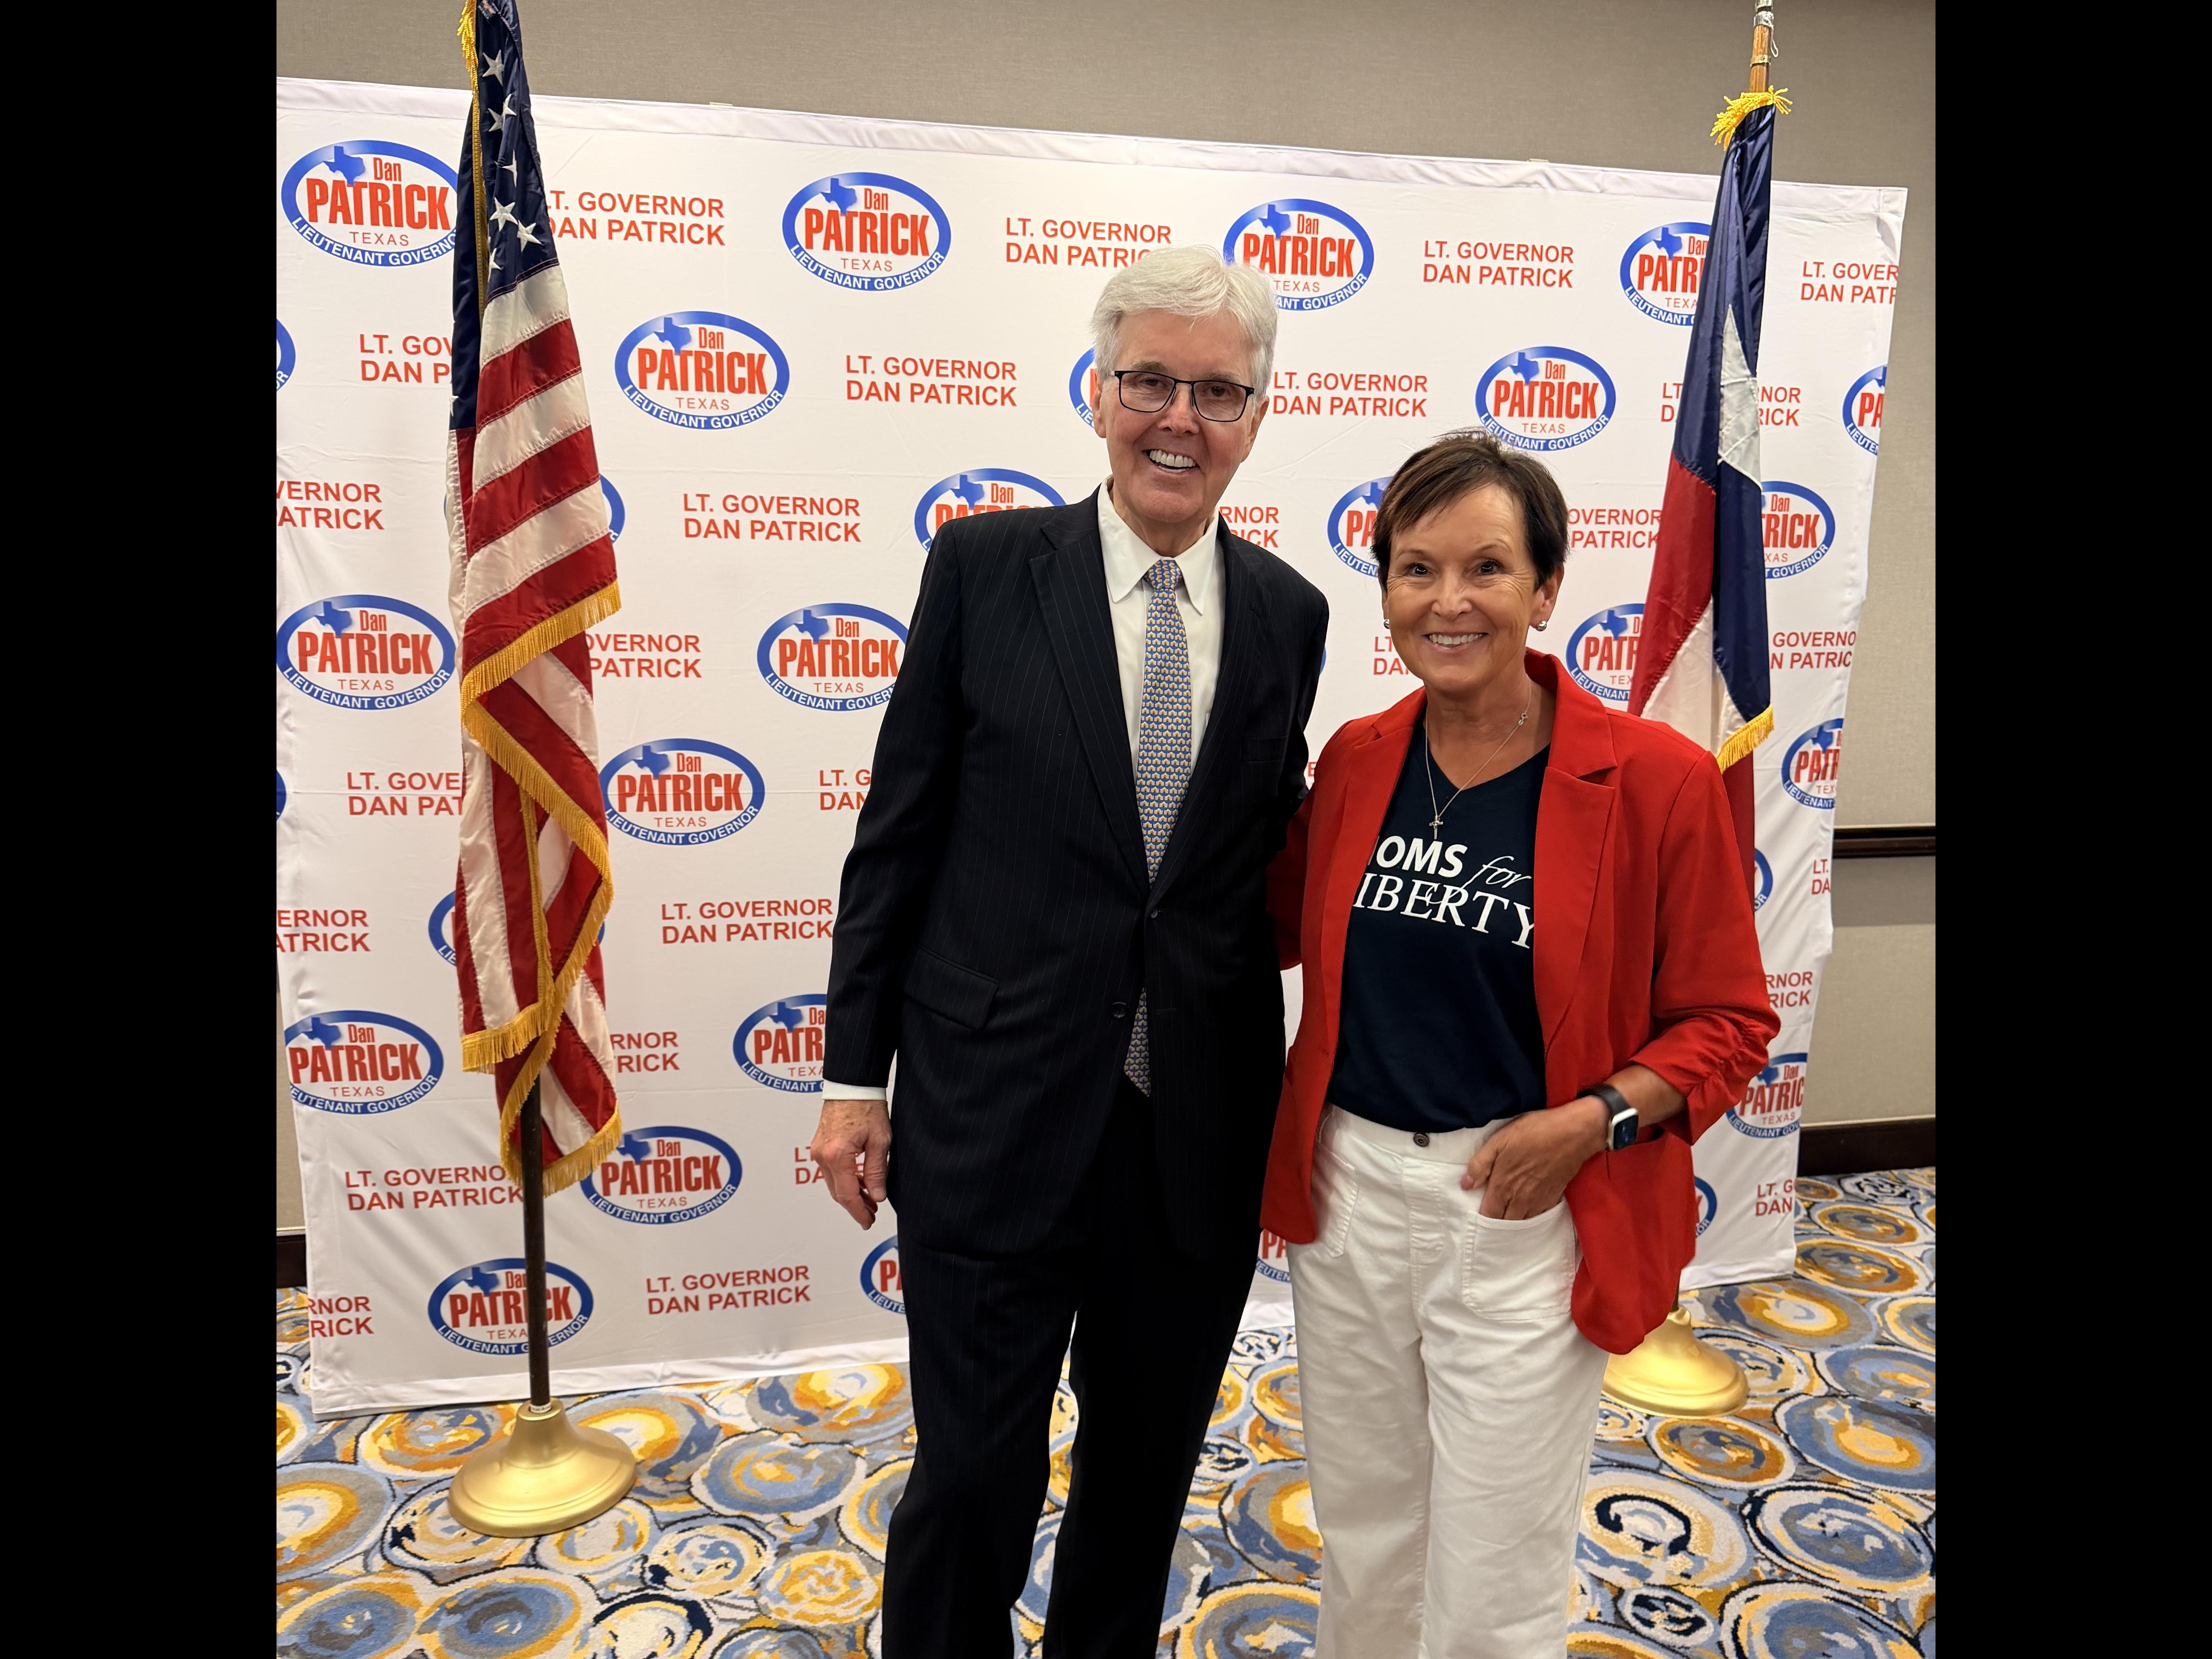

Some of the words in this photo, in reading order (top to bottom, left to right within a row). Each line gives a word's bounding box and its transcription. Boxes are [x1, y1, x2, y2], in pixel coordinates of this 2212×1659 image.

[373, 157, 402, 182] Dan
[306, 178, 451, 230] PATRICK
[547, 190, 569, 210] T.
[578, 192, 724, 218] GOVERNOR
[864, 188, 888, 211] Dan
[608, 219, 725, 246] PATRICK
[804, 208, 929, 257] PATRICK
[1006, 217, 1034, 237] LT.
[1042, 219, 1171, 244] GOVERNOR
[1297, 213, 1319, 235] Dan
[292, 217, 385, 264] LIEUTENANT
[389, 229, 456, 265] GOVERNO
[349, 232, 409, 247] TEXAS
[1006, 242, 1058, 265] DAN
[1243, 233, 1355, 278] PATRICK
[1424, 240, 1449, 258] LT.
[1457, 242, 1574, 263] GOVERNOR
[790, 245, 871, 289] LIEUTENANT
[874, 253, 944, 290] GOVERNOR
[840, 258, 892, 272] TEXAS
[1423, 264, 1470, 284] DAN
[1479, 266, 1573, 288] PATRICK
[1637, 254, 1705, 294] PATR
[1803, 261, 1825, 278] LT.
[1832, 263, 1899, 281] GOVER
[1274, 279, 1320, 293] TEXAS
[1303, 273, 1367, 310] GOVERNOR
[1800, 283, 1844, 302] DAN
[1625, 286, 1688, 325] LIEUTENANT
[1665, 297, 1697, 308] TEXA
[359, 334, 393, 354] LT.
[698, 327, 724, 350] Dan
[361, 360, 422, 383] DAN
[637, 348, 768, 395] PATRICK
[846, 355, 875, 375] LT.
[883, 357, 1016, 381] GOVERNOR
[1544, 360, 1566, 380] Dan
[847, 380, 900, 402] DAN
[910, 383, 1016, 407] PATRICK
[1274, 372, 1299, 390] LT.
[1307, 373, 1427, 393] GOVERNOR
[1662, 383, 1682, 399] LT
[623, 385, 708, 429] LIEUTENANT
[711, 390, 783, 429] GOVERNOR
[675, 397, 730, 411] TEXAS
[1273, 395, 1321, 415] DAN
[1329, 397, 1427, 417] PATRICK
[1493, 380, 1599, 419] PATRICK
[1480, 413, 1545, 450] LIEUTENANT
[1549, 414, 1609, 450] GOVERNOR
[1522, 422, 1566, 434] TEXAS
[276, 480, 382, 503] VERNOR
[991, 483, 1014, 504] Dan
[683, 493, 714, 512] LT.
[722, 494, 860, 517] GOVERNOR
[1770, 493, 1790, 513] Dan
[278, 506, 384, 530] ATRICK
[1219, 506, 1279, 524] RNOR
[1569, 509, 1662, 526] OVERNOR
[684, 517, 740, 539] DAN
[750, 520, 861, 543] PATRICK
[1762, 513, 1820, 549] RICK
[1333, 543, 1377, 575] LIEUTEN
[1764, 551, 1789, 563] XAS
[1772, 544, 1829, 578] GOVERNOR
[360, 610, 386, 632] Dan
[835, 617, 860, 638] Dan
[1374, 636, 1393, 652] LT
[1772, 631, 1857, 647] GOVERNO
[297, 631, 434, 675] PATRICK
[778, 638, 899, 678] PATRICK
[1790, 651, 1853, 669] PATRIC
[283, 666, 371, 709] LIEUTENANT
[374, 670, 451, 708] GOVERNOR
[336, 678, 395, 692] TEXAS
[765, 673, 843, 710] LIEUTENANT
[812, 682, 864, 694] TEXAS
[677, 753, 701, 772] Dan
[1794, 748, 1841, 783] PATR
[347, 772, 380, 790] LT.
[388, 772, 461, 790] GOVE
[819, 769, 848, 787] LT.
[1815, 784, 1835, 794] TEX
[617, 774, 743, 812] PATRICK
[348, 795, 408, 816] DAN
[605, 809, 684, 845] LIEUTENANT
[688, 806, 759, 845] GOVERNOR
[653, 815, 709, 830] TEXAS
[1368, 836, 1467, 878] OMS
[1426, 856, 1532, 905] for
[1813, 859, 1827, 874] LT.
[1811, 878, 1830, 895] DA
[277, 909, 368, 928] ERNOR
[661, 903, 691, 921] LT.
[699, 899, 833, 919] GOVERNOR
[1352, 872, 1534, 948] IBERTY
[276, 932, 371, 953] ATRICK
[661, 924, 717, 945] DAN
[726, 920, 833, 942] PATRICK
[1765, 972, 1812, 988] RNOR
[1769, 990, 1810, 1008] RICK
[809, 1008, 826, 1025] Da
[348, 1024, 375, 1043] Dan
[611, 1032, 678, 1050] RNOR
[754, 1027, 823, 1064] PATR
[289, 1044, 422, 1084] PATRICK
[616, 1052, 680, 1074] RICK
[1784, 1065, 1799, 1080] Dan
[741, 1061, 815, 1092] LIEUTENANT
[290, 1087, 362, 1113] EUTENANT
[368, 1075, 438, 1113] GOVERNOR
[329, 1085, 385, 1098] TEXAS
[1741, 1078, 1805, 1116] PATRIC
[1762, 1112, 1795, 1125] TEXAS
[658, 1140, 681, 1158] Dan
[345, 1171, 376, 1188] LT.
[384, 1165, 506, 1187] GOVERNO
[601, 1155, 722, 1196] PATRICK
[347, 1192, 404, 1211] DAN
[414, 1187, 523, 1209] PATRICK
[1757, 1182, 1778, 1198] LT.
[589, 1193, 666, 1223] LIEUTENANT
[670, 1184, 736, 1223] GOVERNOR
[636, 1196, 688, 1209] TEXAS
[1755, 1197, 1793, 1216] DAN
[646, 1276, 675, 1293] LT.
[682, 1266, 809, 1291] GOVERNOR
[648, 1295, 700, 1315] DAN
[708, 1285, 810, 1310] PATRICK
[869, 1291, 905, 1313] LIEUTE
[311, 1317, 374, 1338] RICK
[437, 1325, 517, 1354] LIEUTENANT
[521, 1314, 587, 1353] GERNOR
[487, 1329, 527, 1340] TEXA
